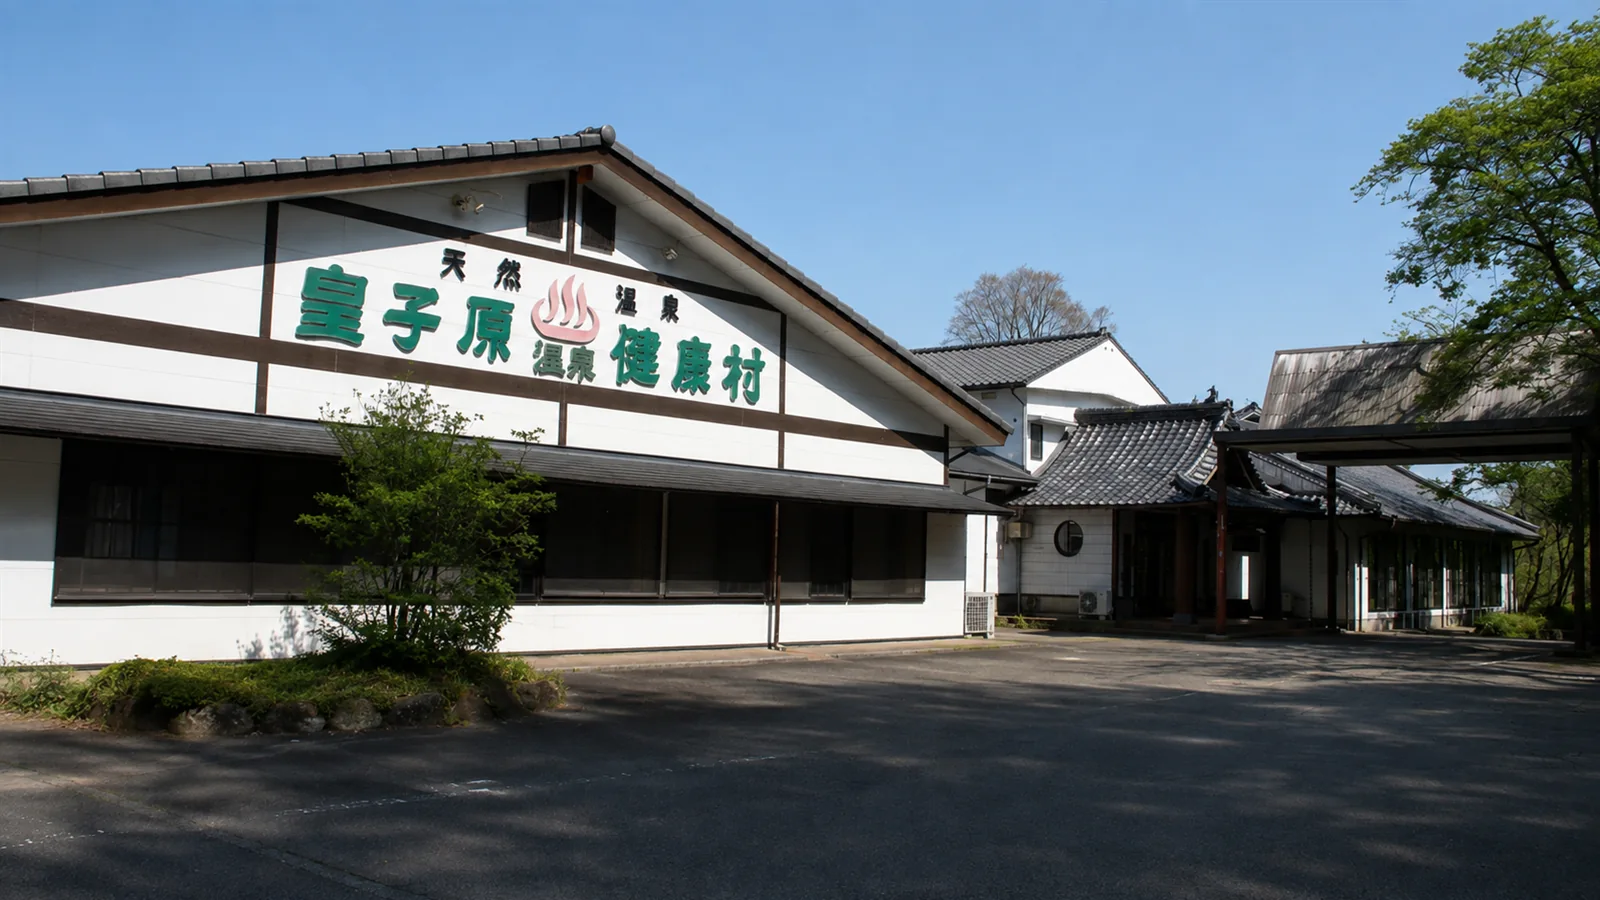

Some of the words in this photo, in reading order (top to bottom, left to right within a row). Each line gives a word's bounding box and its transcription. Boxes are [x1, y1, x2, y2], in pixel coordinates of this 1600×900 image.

[295, 264, 515, 364] 皇子原
[532, 340, 597, 384] 温泉
[610, 324, 766, 405] 健康村
[440, 248, 521, 292] 天然
[615, 284, 680, 324] 温泉
